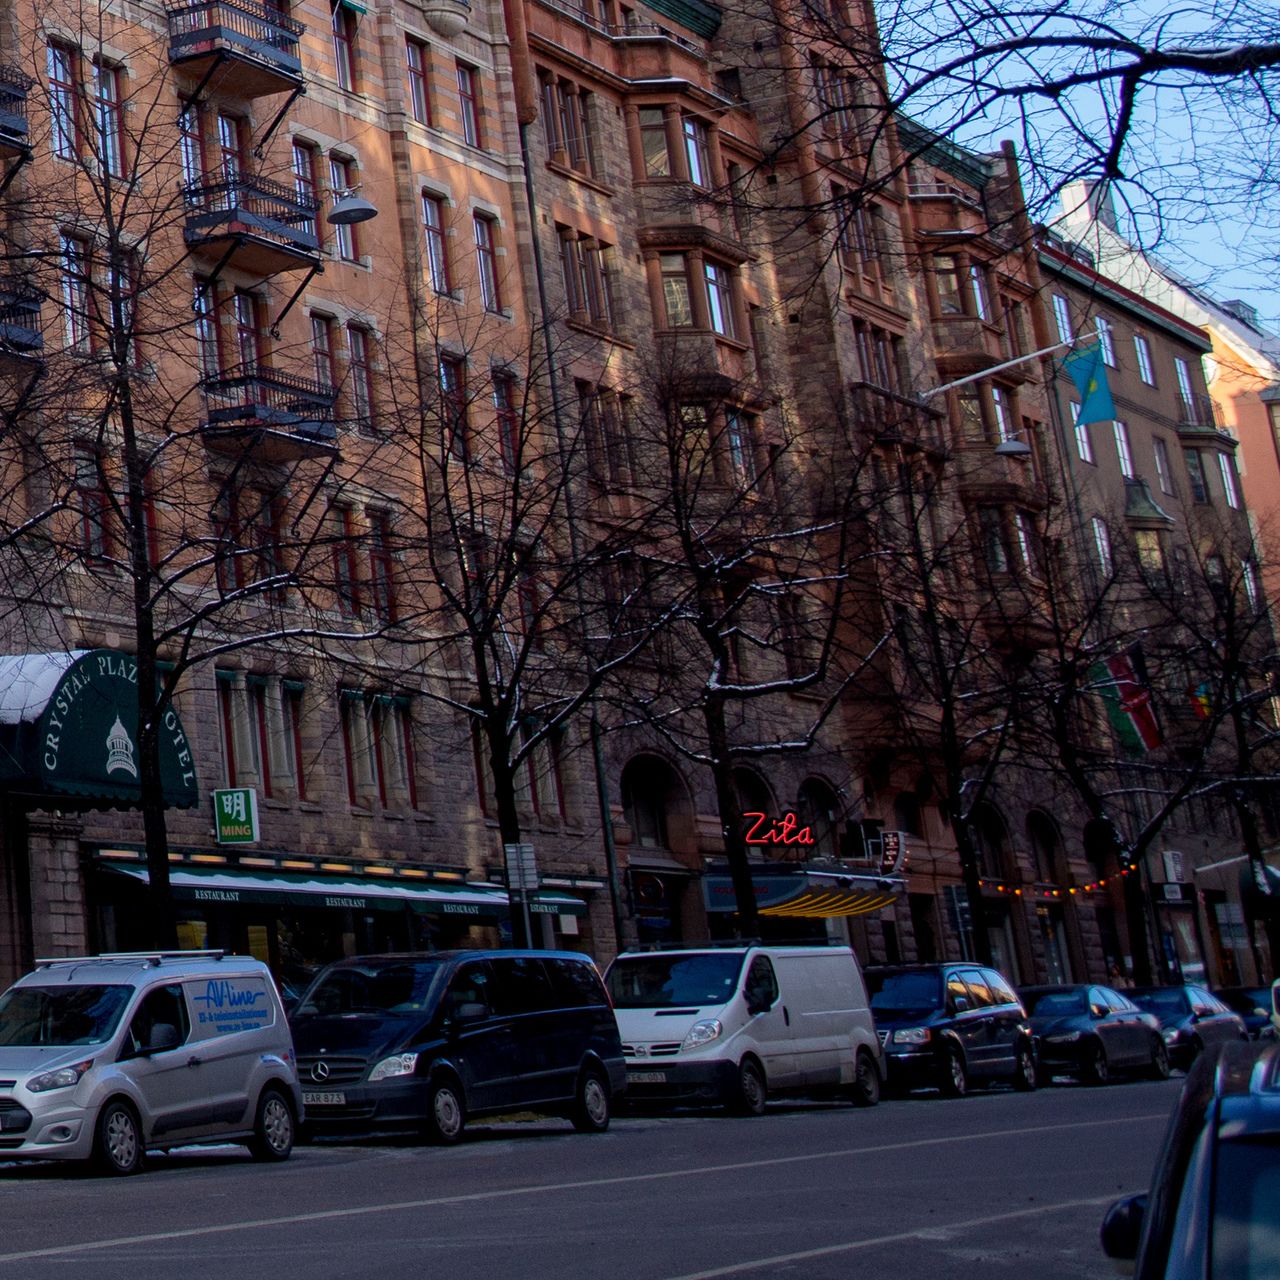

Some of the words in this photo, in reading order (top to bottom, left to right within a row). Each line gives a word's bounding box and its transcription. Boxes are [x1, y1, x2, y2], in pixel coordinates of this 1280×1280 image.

[44, 664, 90, 771] CRYSTAL
[97, 656, 138, 684] PLAZ
[221, 792, 246, 822] 明
[221, 824, 252, 837] MING
[742, 811, 816, 846] Zita
[195, 888, 240, 902] RESTAURANT
[325, 897, 366, 909] RESTAURANT
[443, 903, 479, 915] RESTAURANT
[530, 903, 559, 914] ESTAURANT
[305, 1094, 321, 1103] EAR
[324, 1094, 342, 1103] 873
